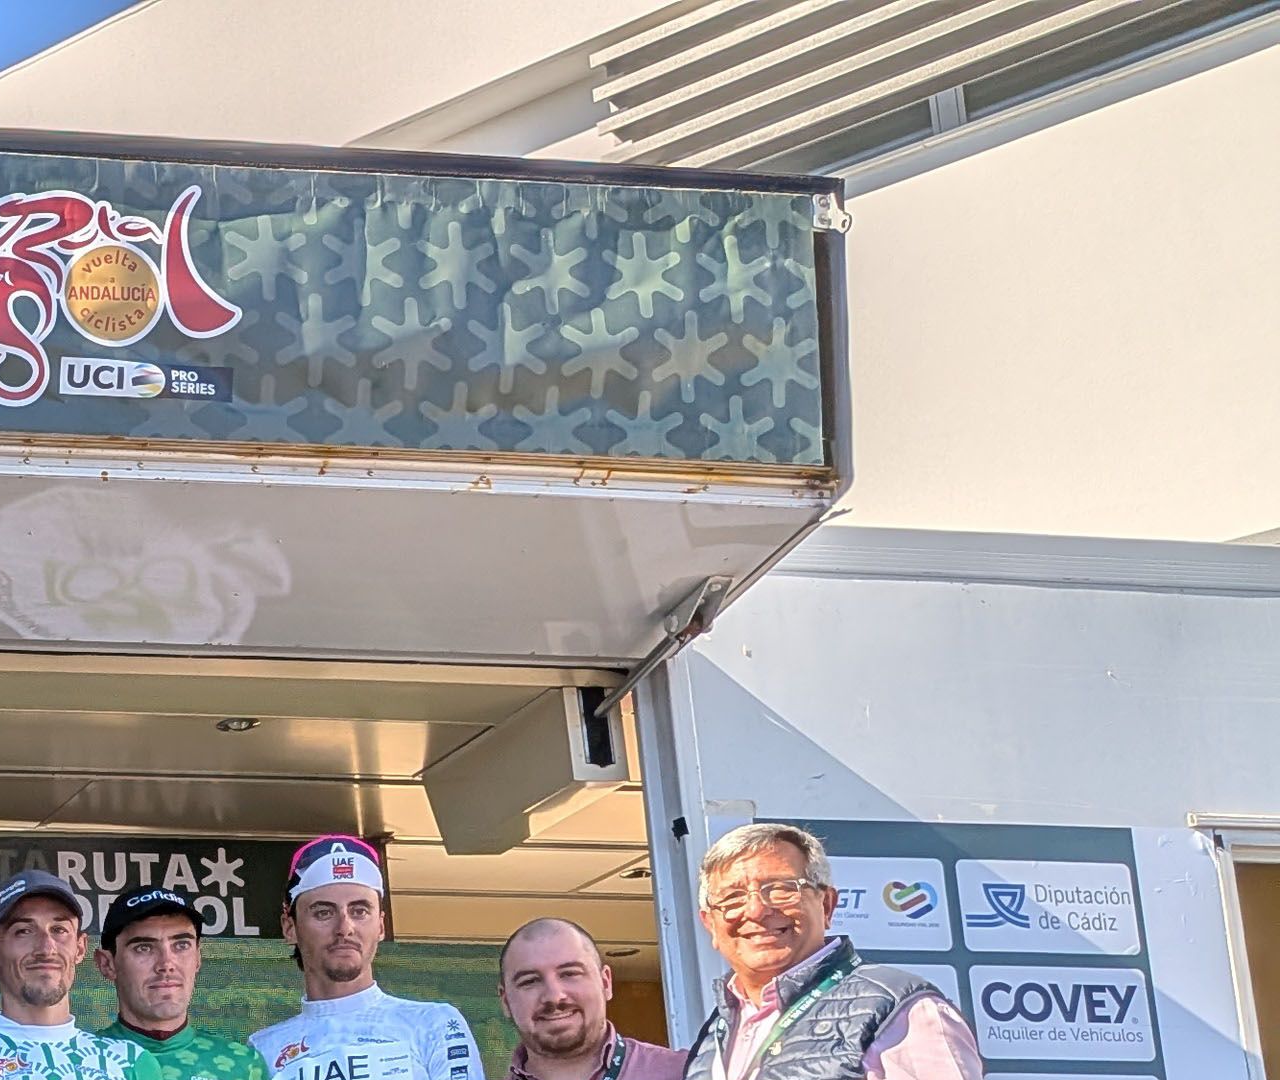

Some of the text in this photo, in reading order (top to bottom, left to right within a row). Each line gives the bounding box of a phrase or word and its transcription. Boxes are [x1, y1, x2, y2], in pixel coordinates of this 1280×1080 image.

[81, 250, 138, 275] vuelta
[68, 284, 156, 302] ANDALUCÍA
[79, 306, 145, 333] ciclista
[67, 363, 125, 390] UCI
[171, 370, 199, 383] PRO
[171, 381, 215, 395] SERIES
[57, 851, 200, 893] RUTA
[332, 857, 355, 867] UAE
[126, 887, 186, 908] Cofidis
[1034, 884, 1131, 906] Diputación
[1038, 911, 1118, 931] de Cádiz
[981, 981, 1137, 1025] COVEY
[988, 1026, 1144, 1044] Alquiler de Vehículos
